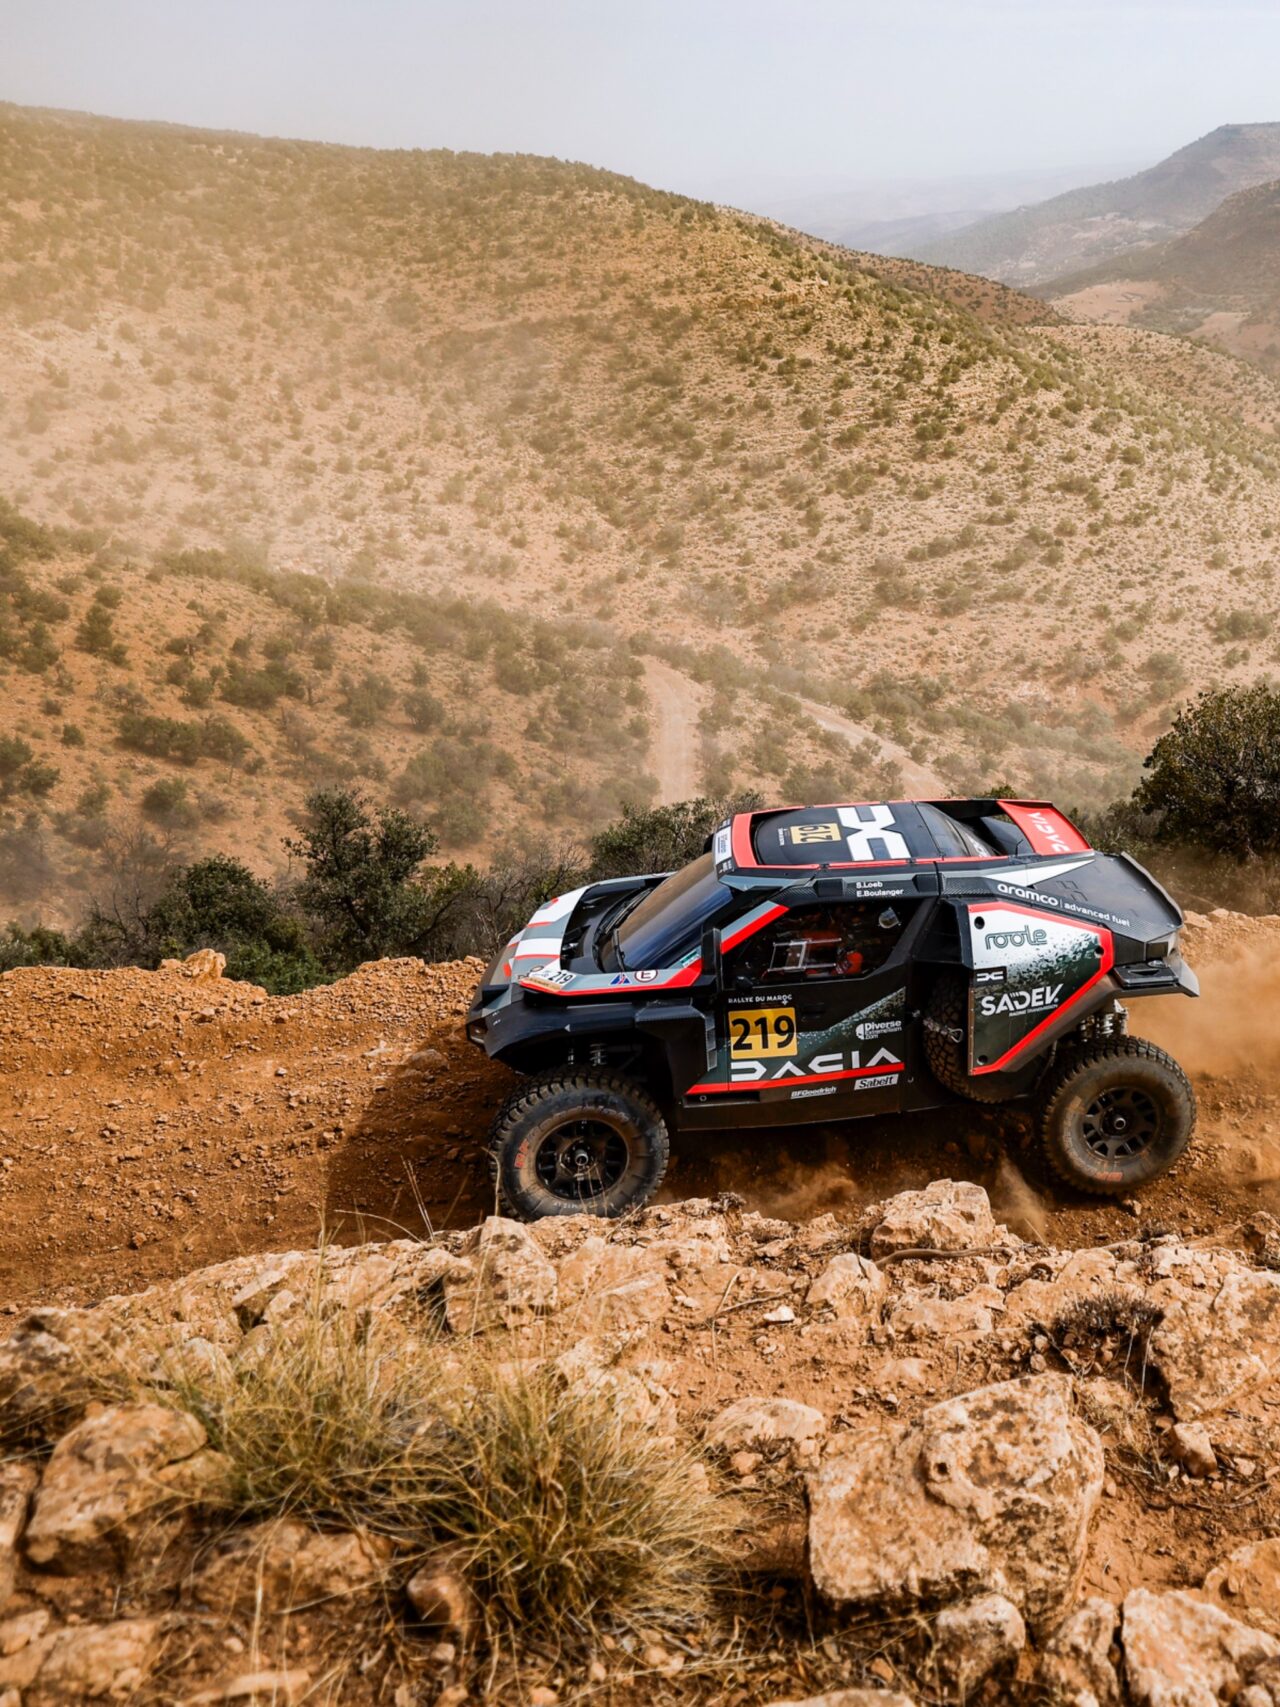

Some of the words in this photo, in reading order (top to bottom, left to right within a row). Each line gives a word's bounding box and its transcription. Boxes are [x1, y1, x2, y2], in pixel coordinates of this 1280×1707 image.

[798, 825, 833, 842] 219
[856, 881, 883, 889] S.Loeb
[856, 889, 904, 897] E.Boulanger
[997, 884, 1059, 906] aramco
[1064, 903, 1110, 920] advanced
[1112, 915, 1131, 927] fuel
[985, 925, 1048, 950] roole
[548, 971, 574, 985] 219
[767, 994, 792, 1002] MAROC
[865, 1020, 902, 1031] Diverse
[731, 1015, 795, 1051] 219
[731, 1048, 901, 1081] DACIA
[859, 1077, 894, 1088] Sabelt
